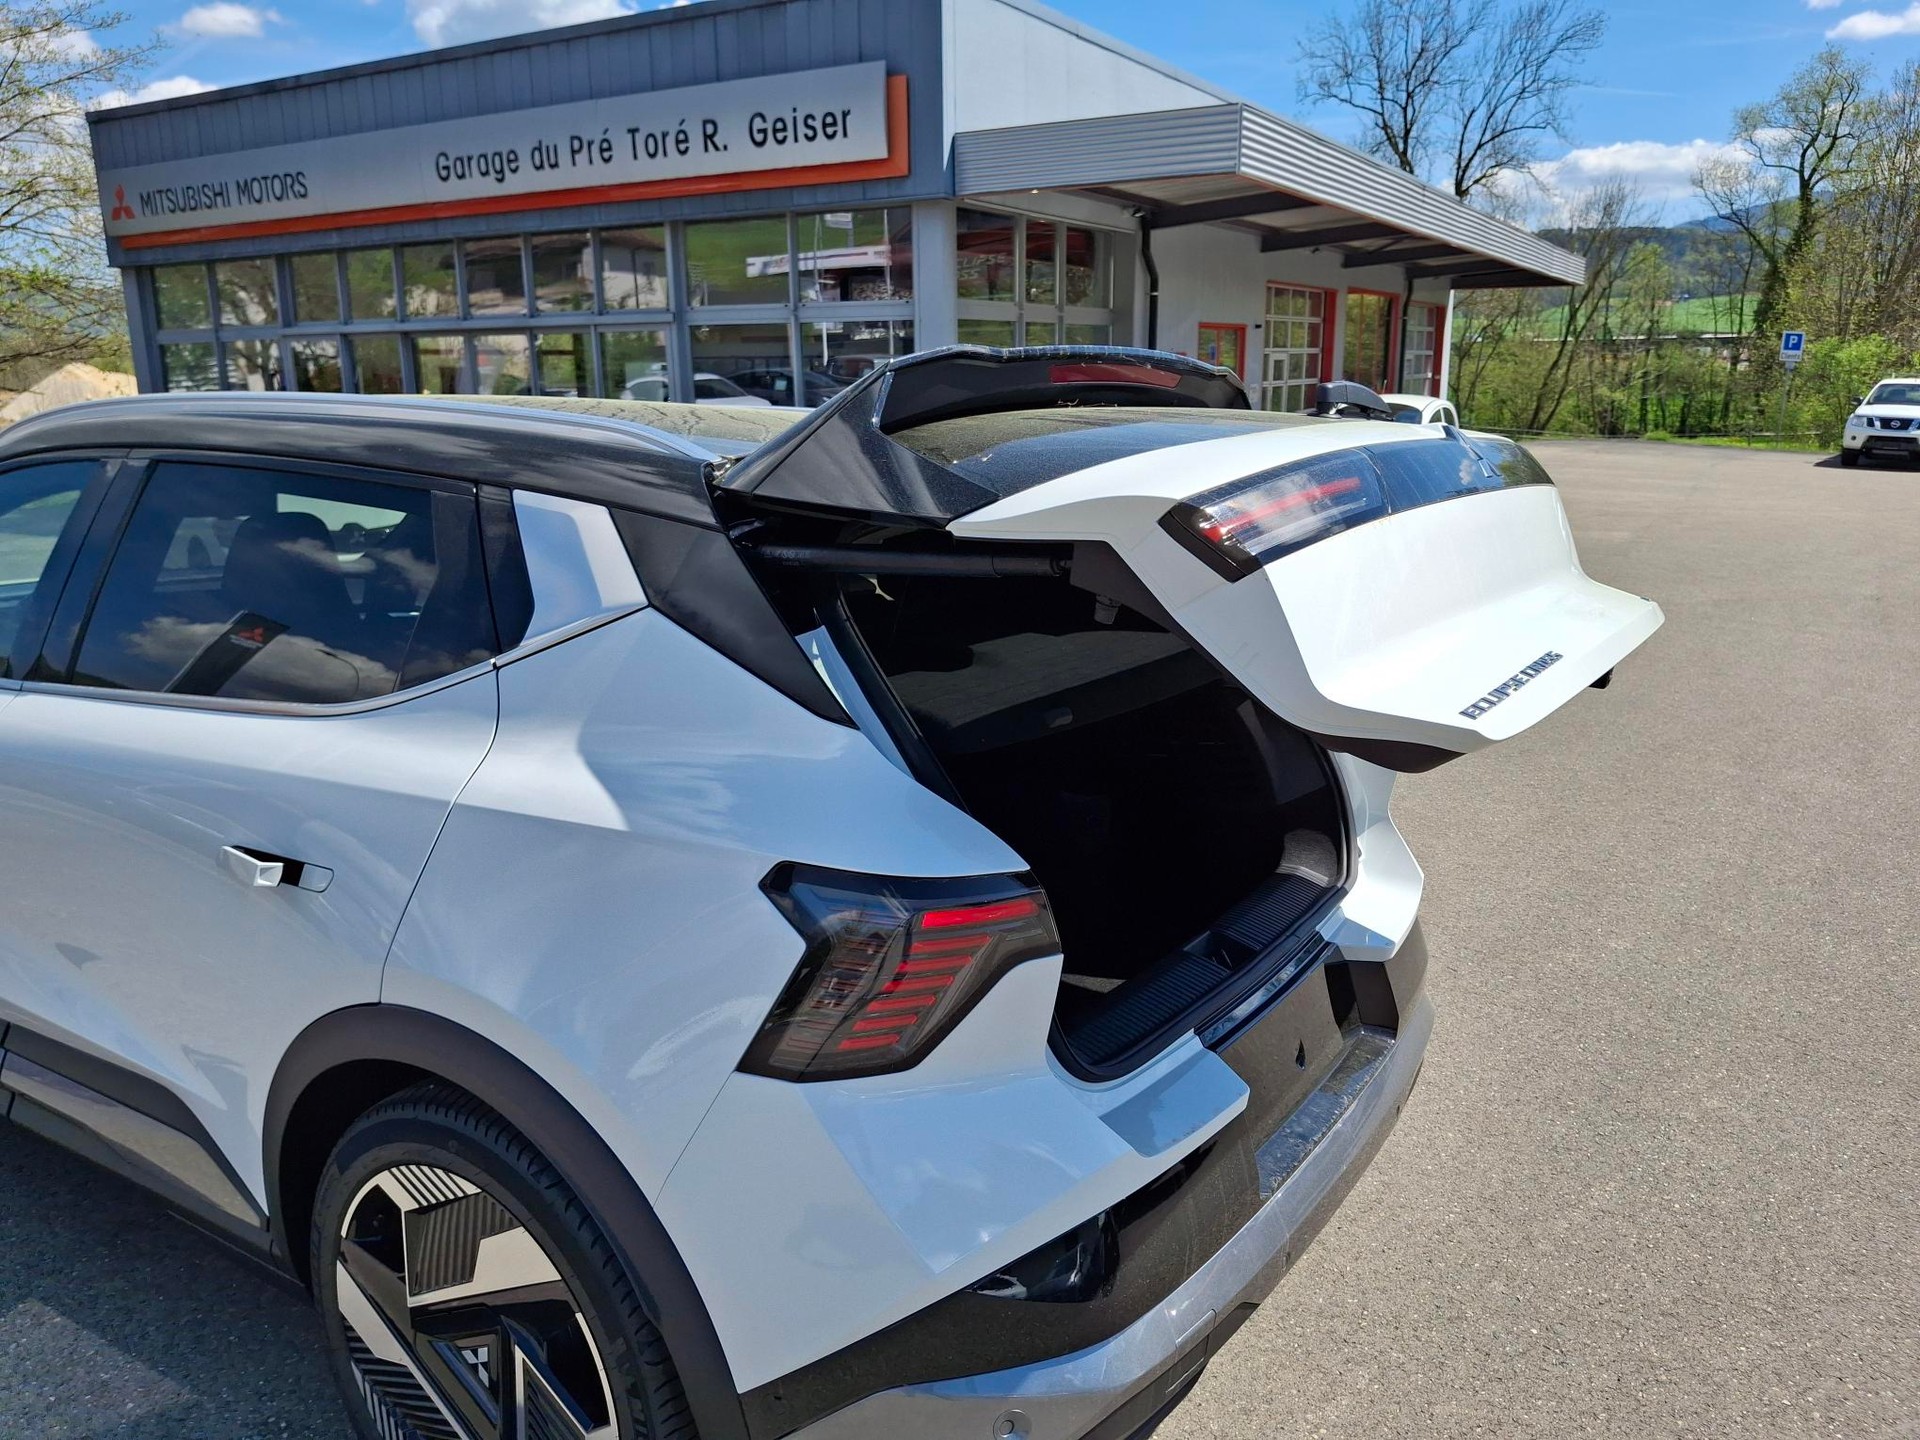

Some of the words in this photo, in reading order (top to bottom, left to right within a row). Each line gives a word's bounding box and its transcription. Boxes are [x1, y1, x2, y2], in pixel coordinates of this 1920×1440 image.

[435, 148, 520, 183] Garage
[530, 140, 560, 171] du
[569, 128, 614, 168] Pré
[627, 119, 690, 161] Toré
[701, 118, 729, 154] R.
[748, 107, 852, 148] Geiser
[139, 181, 232, 217] MITSUBISHI
[236, 171, 308, 206] MOTORS
[1788, 335, 1799, 348] P
